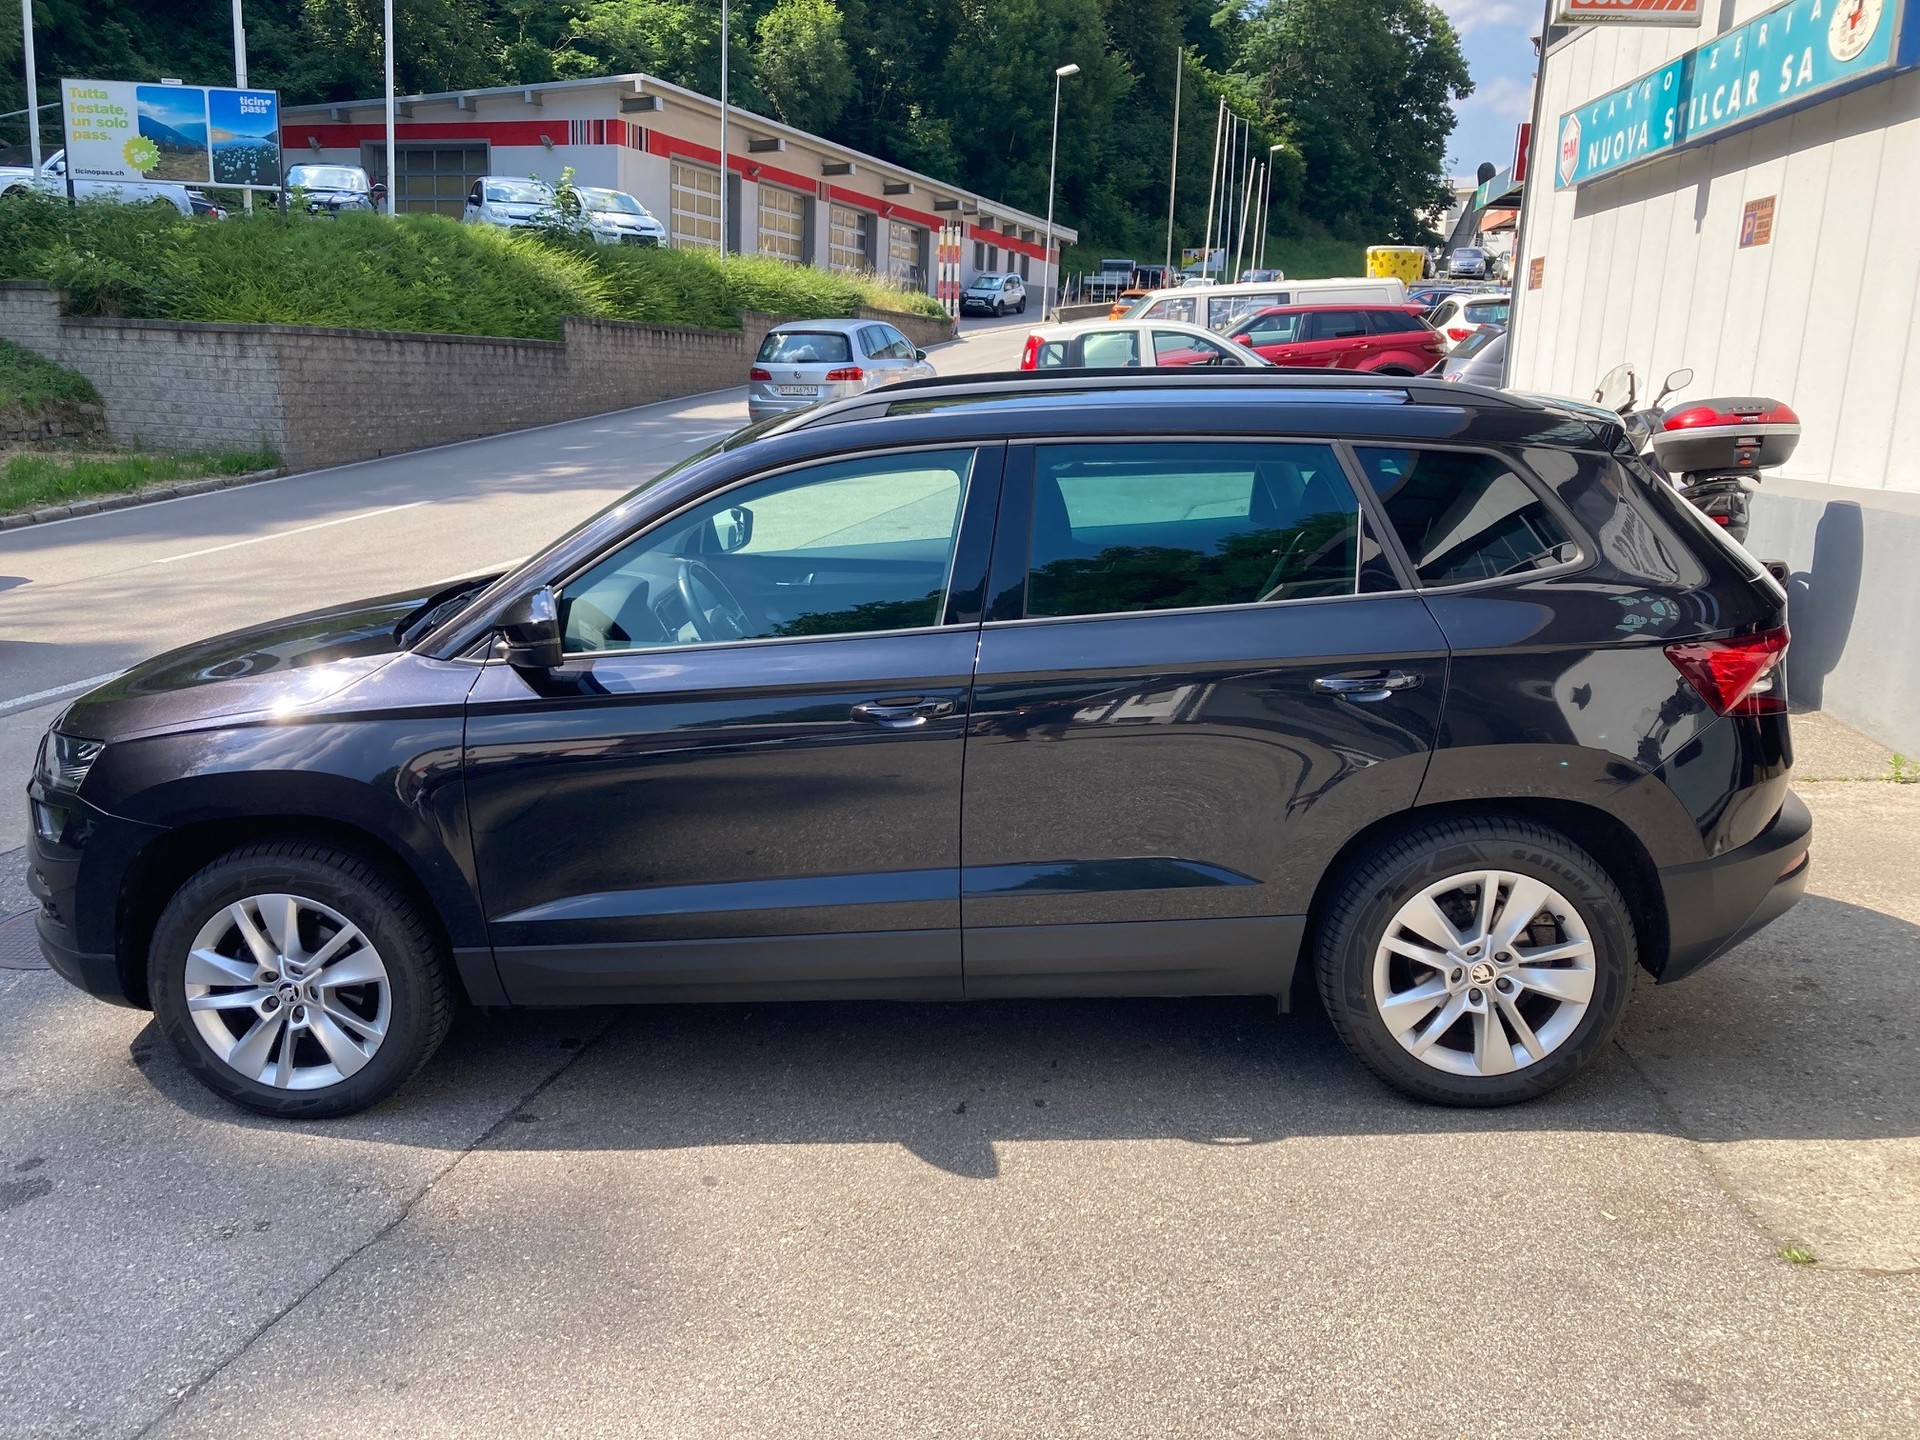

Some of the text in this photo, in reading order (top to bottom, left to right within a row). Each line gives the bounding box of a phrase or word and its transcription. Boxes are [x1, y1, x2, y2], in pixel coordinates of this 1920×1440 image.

[1591, 0, 1822, 126] CARROZZERIA
[70, 87, 108, 100] Tutta
[70, 102, 128, 118] l'estate,
[240, 105, 267, 115] pass
[1587, 46, 1813, 170] NUOVA STILCAR SA
[71, 117, 129, 129] un solo
[72, 130, 112, 143] pass.
[75, 168, 125, 176] ticinopass.ch
[1510, 848, 1590, 893] SAILUN
